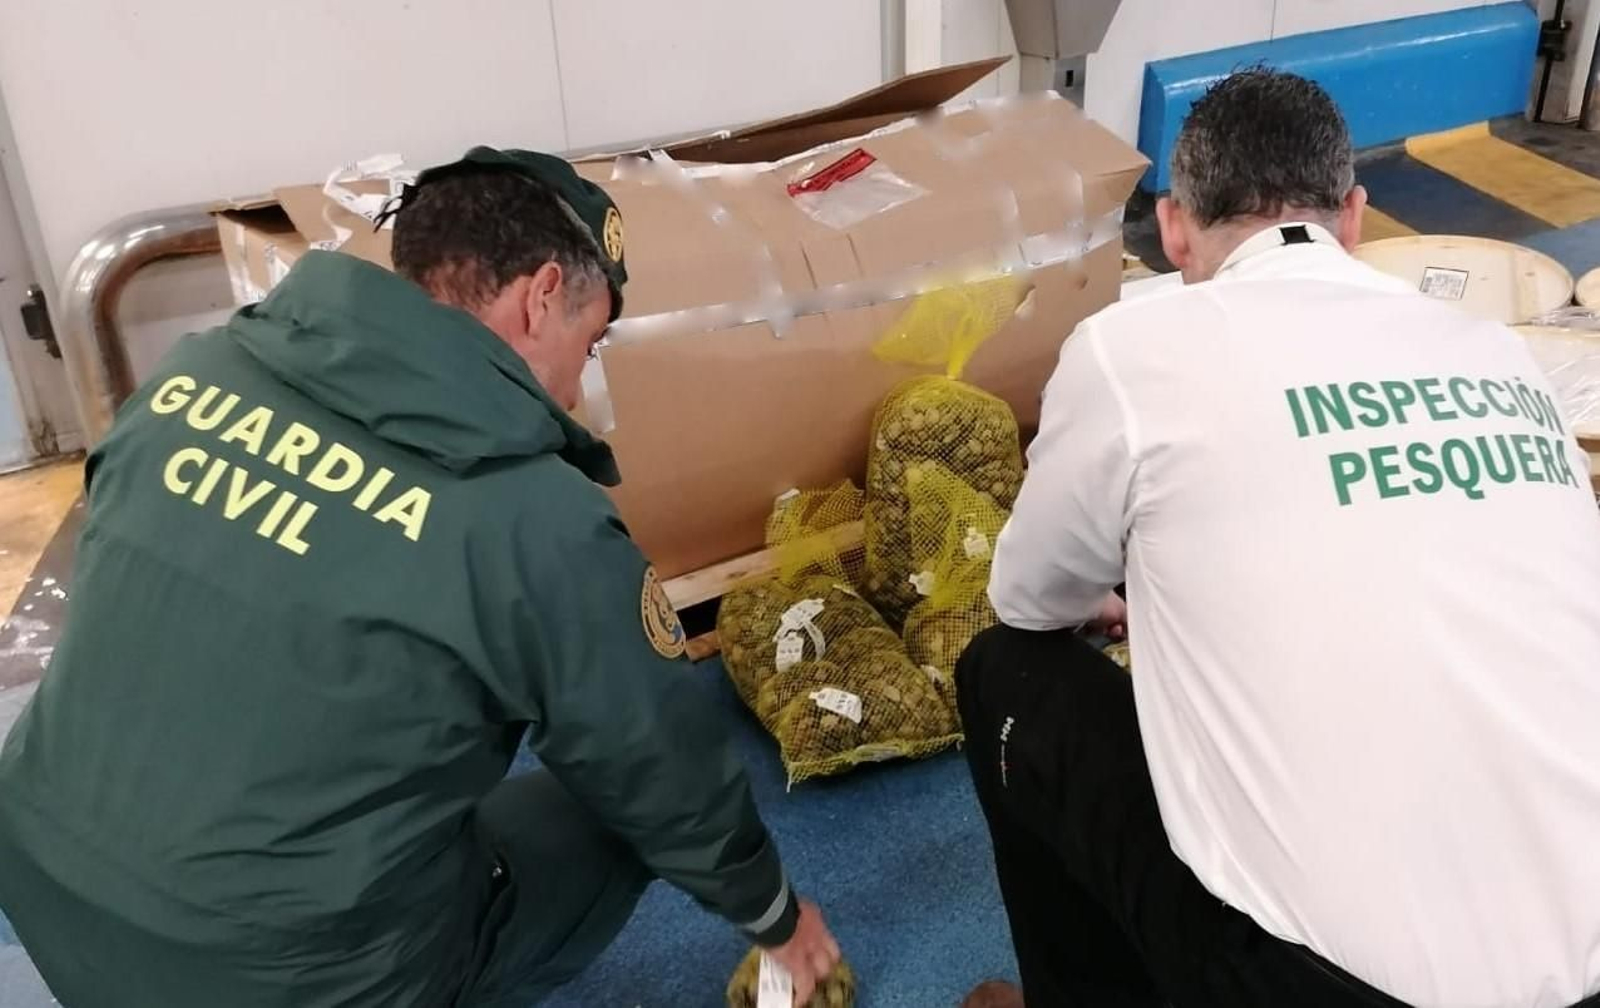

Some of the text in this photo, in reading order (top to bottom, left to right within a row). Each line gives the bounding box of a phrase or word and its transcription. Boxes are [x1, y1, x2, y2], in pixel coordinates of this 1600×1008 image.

[1284, 376, 1565, 438] INSPECCIÓN
[150, 375, 432, 542] GUARDIA
[163, 447, 319, 555] CIVIL
[1328, 434, 1580, 506] PESQUERA
